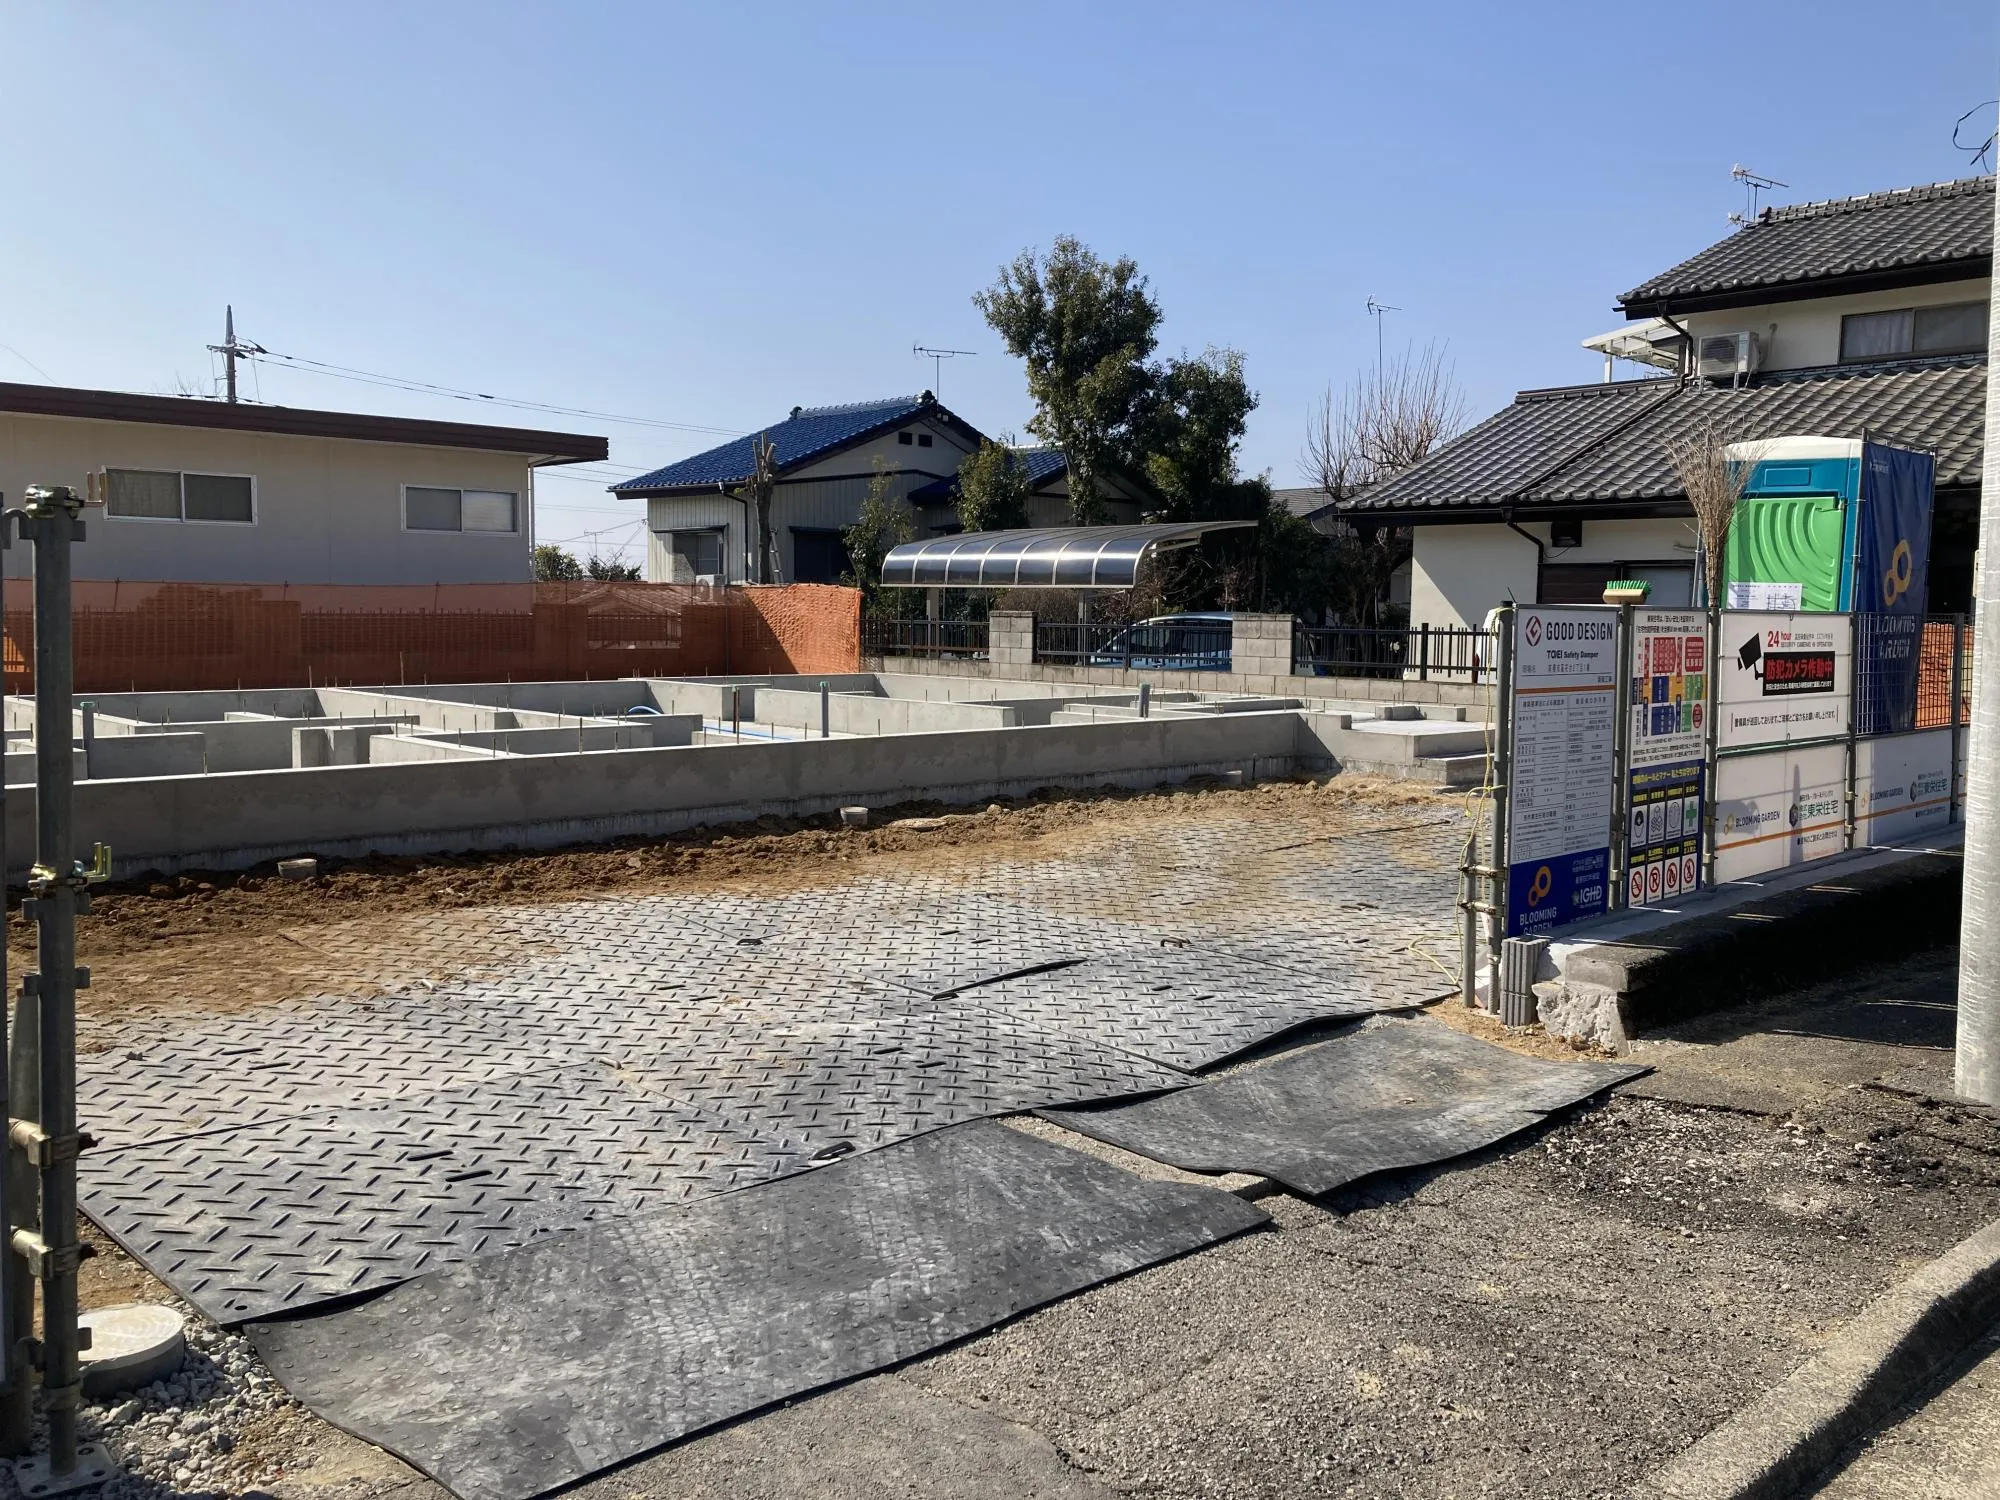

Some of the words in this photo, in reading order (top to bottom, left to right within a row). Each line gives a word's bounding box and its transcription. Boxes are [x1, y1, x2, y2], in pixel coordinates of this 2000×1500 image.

[1546, 622, 1575, 641] GOOD
[1577, 622, 1613, 641] DESIGN
[1767, 631, 1780, 648] 24
[1780, 632, 1792, 641] hour
[1563, 651, 1580, 660] Safety
[1580, 650, 1599, 659] Damper
[1766, 658, 1833, 681] 防犯カメラ作動中
[1808, 800, 1839, 818] 東栄住宅
[1735, 814, 1761, 828] BLOOMING
[1761, 810, 1780, 822] GARDEN
[1519, 907, 1557, 926] BLOOMING
